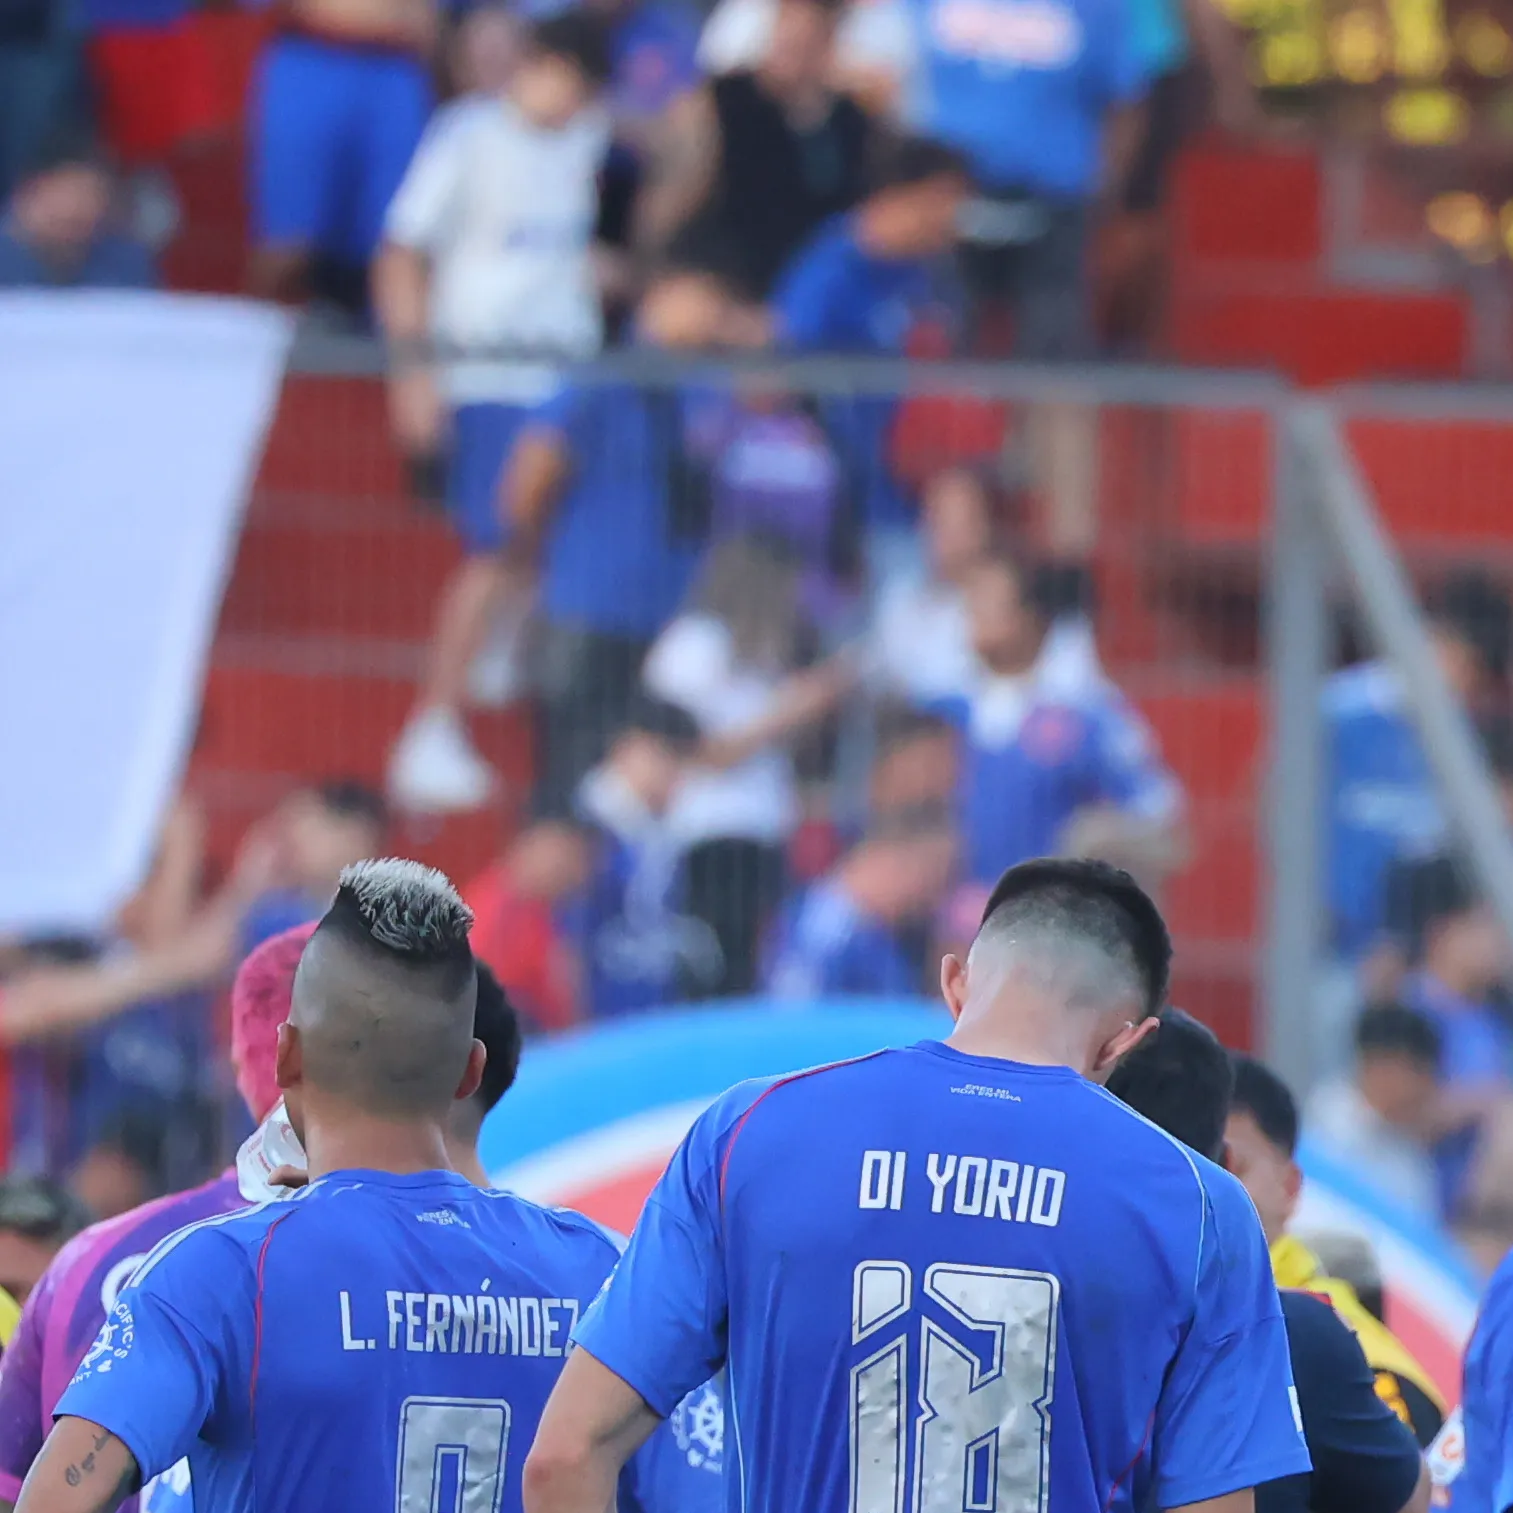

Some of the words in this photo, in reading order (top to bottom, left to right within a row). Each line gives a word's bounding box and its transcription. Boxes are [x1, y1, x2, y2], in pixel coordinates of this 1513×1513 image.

[857, 1149, 906, 1210] DI
[926, 1154, 1066, 1228] YORIO
[339, 1290, 377, 1351] L.
